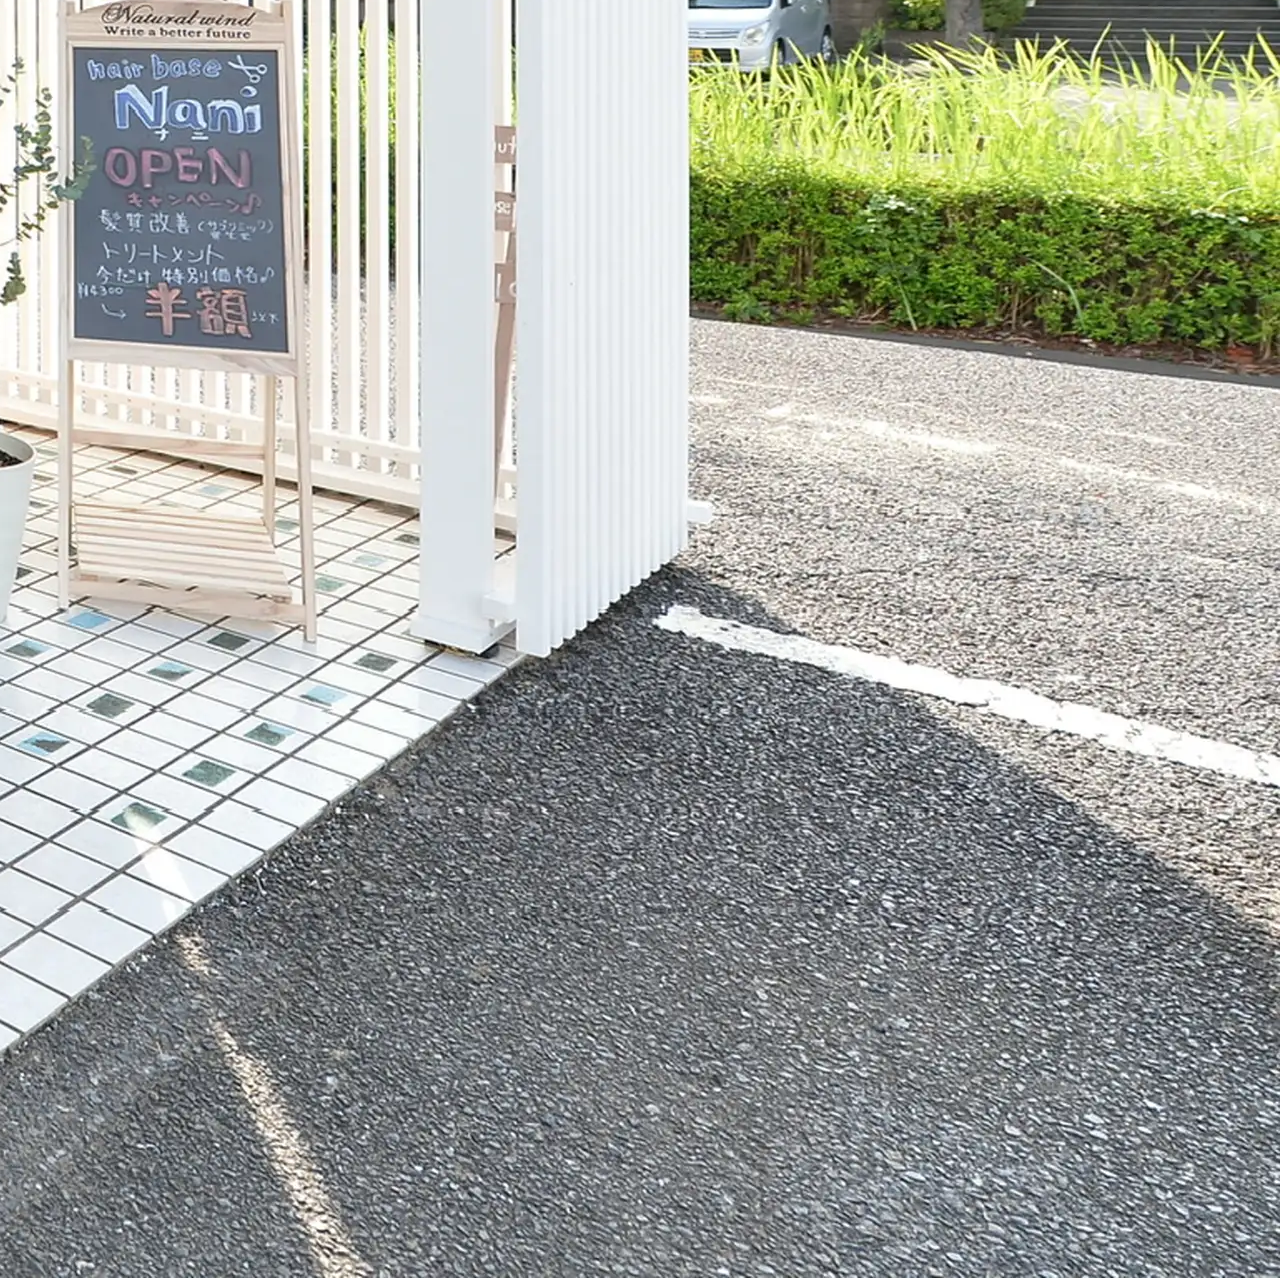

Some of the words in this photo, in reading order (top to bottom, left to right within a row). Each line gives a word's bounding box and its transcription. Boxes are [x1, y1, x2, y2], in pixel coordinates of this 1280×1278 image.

[101, 2, 199, 26] Natural
[198, 12, 257, 27] wind
[104, 26, 145, 36] Write
[148, 29, 156, 37] a
[160, 27, 202, 38] better
[206, 28, 251, 39] future
[87, 59, 144, 80] hair
[151, 54, 223, 81] base
[114, 84, 262, 134] Nani
[105, 147, 251, 188] OPEN
[98, 209, 190, 234] 髪質改善
[102, 242, 225, 265] トリートメント
[96, 265, 151, 284] 今だけ
[162, 265, 258, 284] 特別価格
[145, 282, 252, 338] 半額
